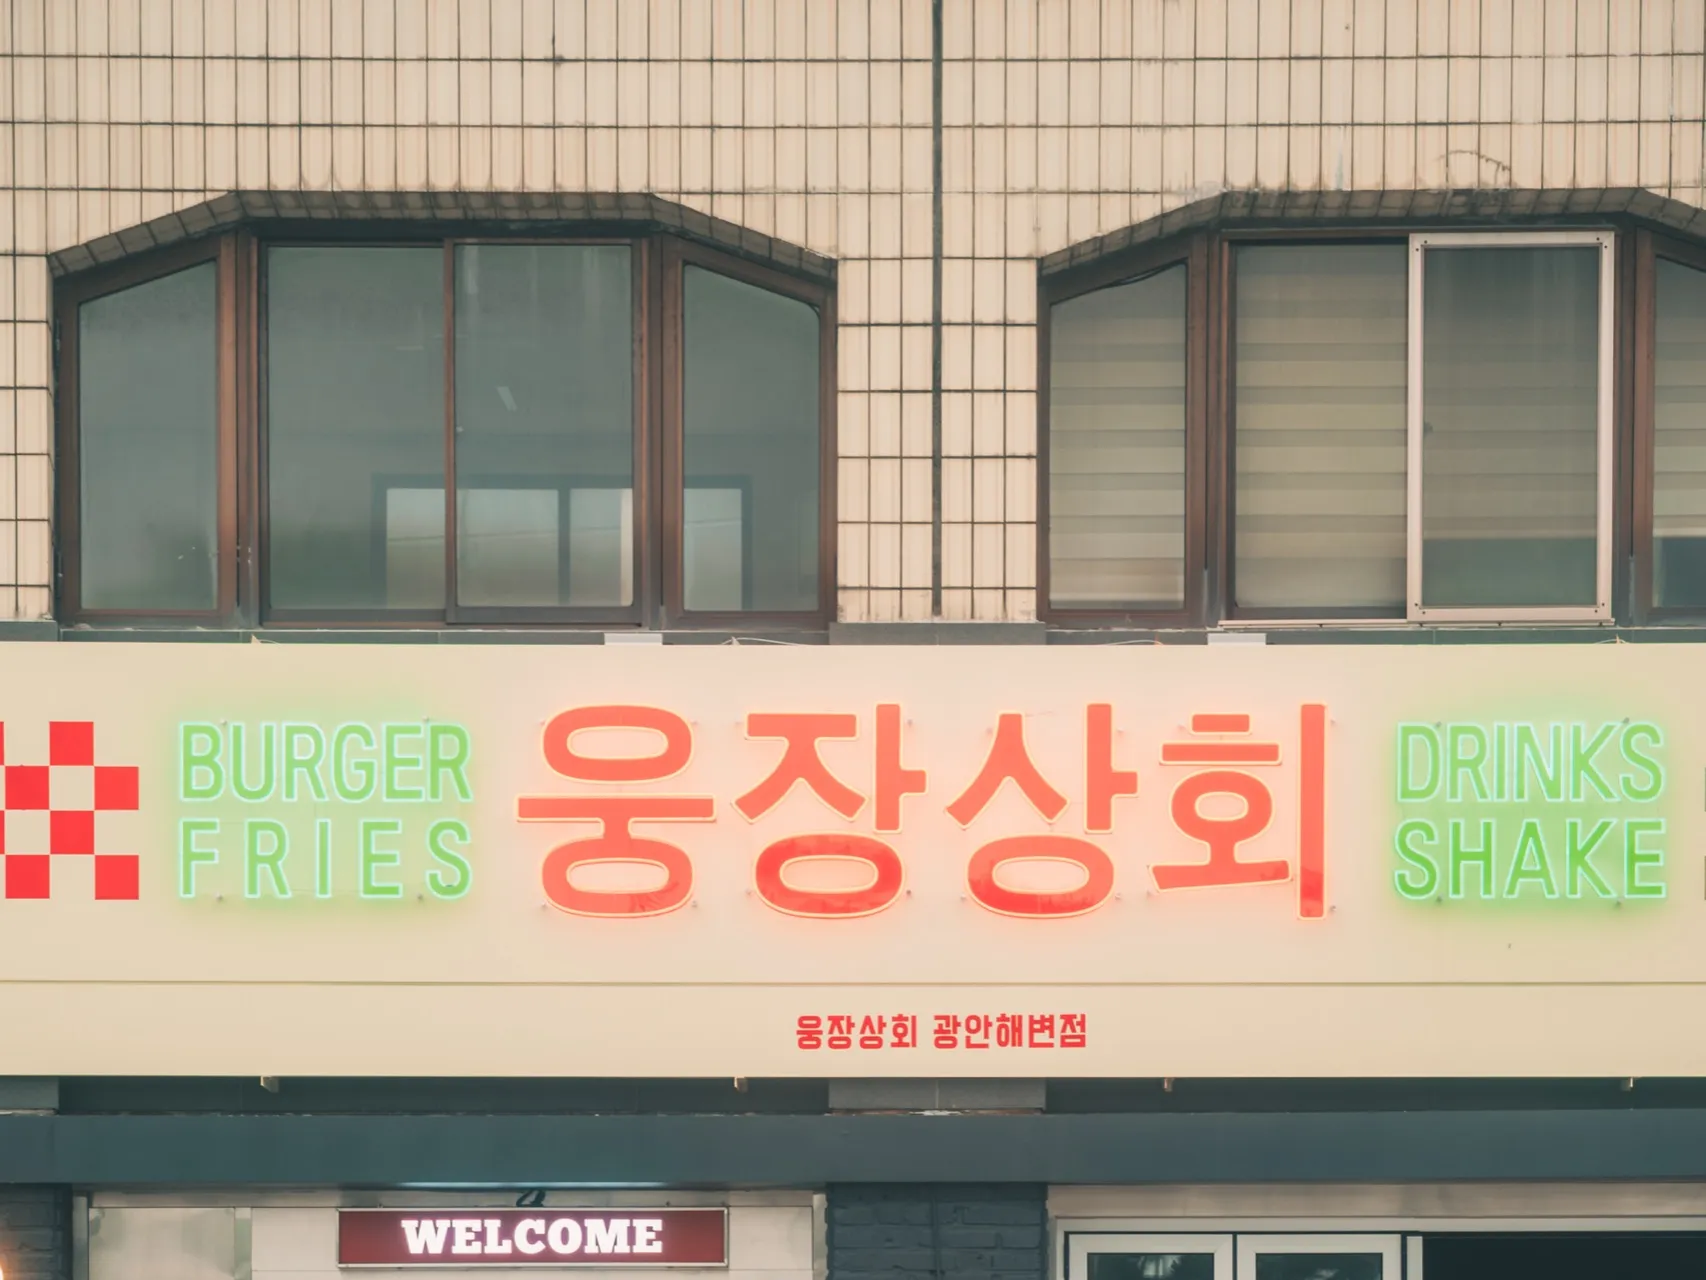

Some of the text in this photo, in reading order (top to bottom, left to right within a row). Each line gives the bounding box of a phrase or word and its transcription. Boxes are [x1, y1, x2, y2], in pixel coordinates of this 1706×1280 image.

[178, 720, 474, 803] BURGER
[1395, 720, 1667, 804] DRINKS
[516, 703, 1328, 920] 웅장상회
[178, 817, 474, 900] FRIES
[1393, 817, 1669, 901] SHAKE
[796, 1013, 1087, 1050] 웅장상회 광안해변점
[400, 1218, 664, 1256] WELCOME
